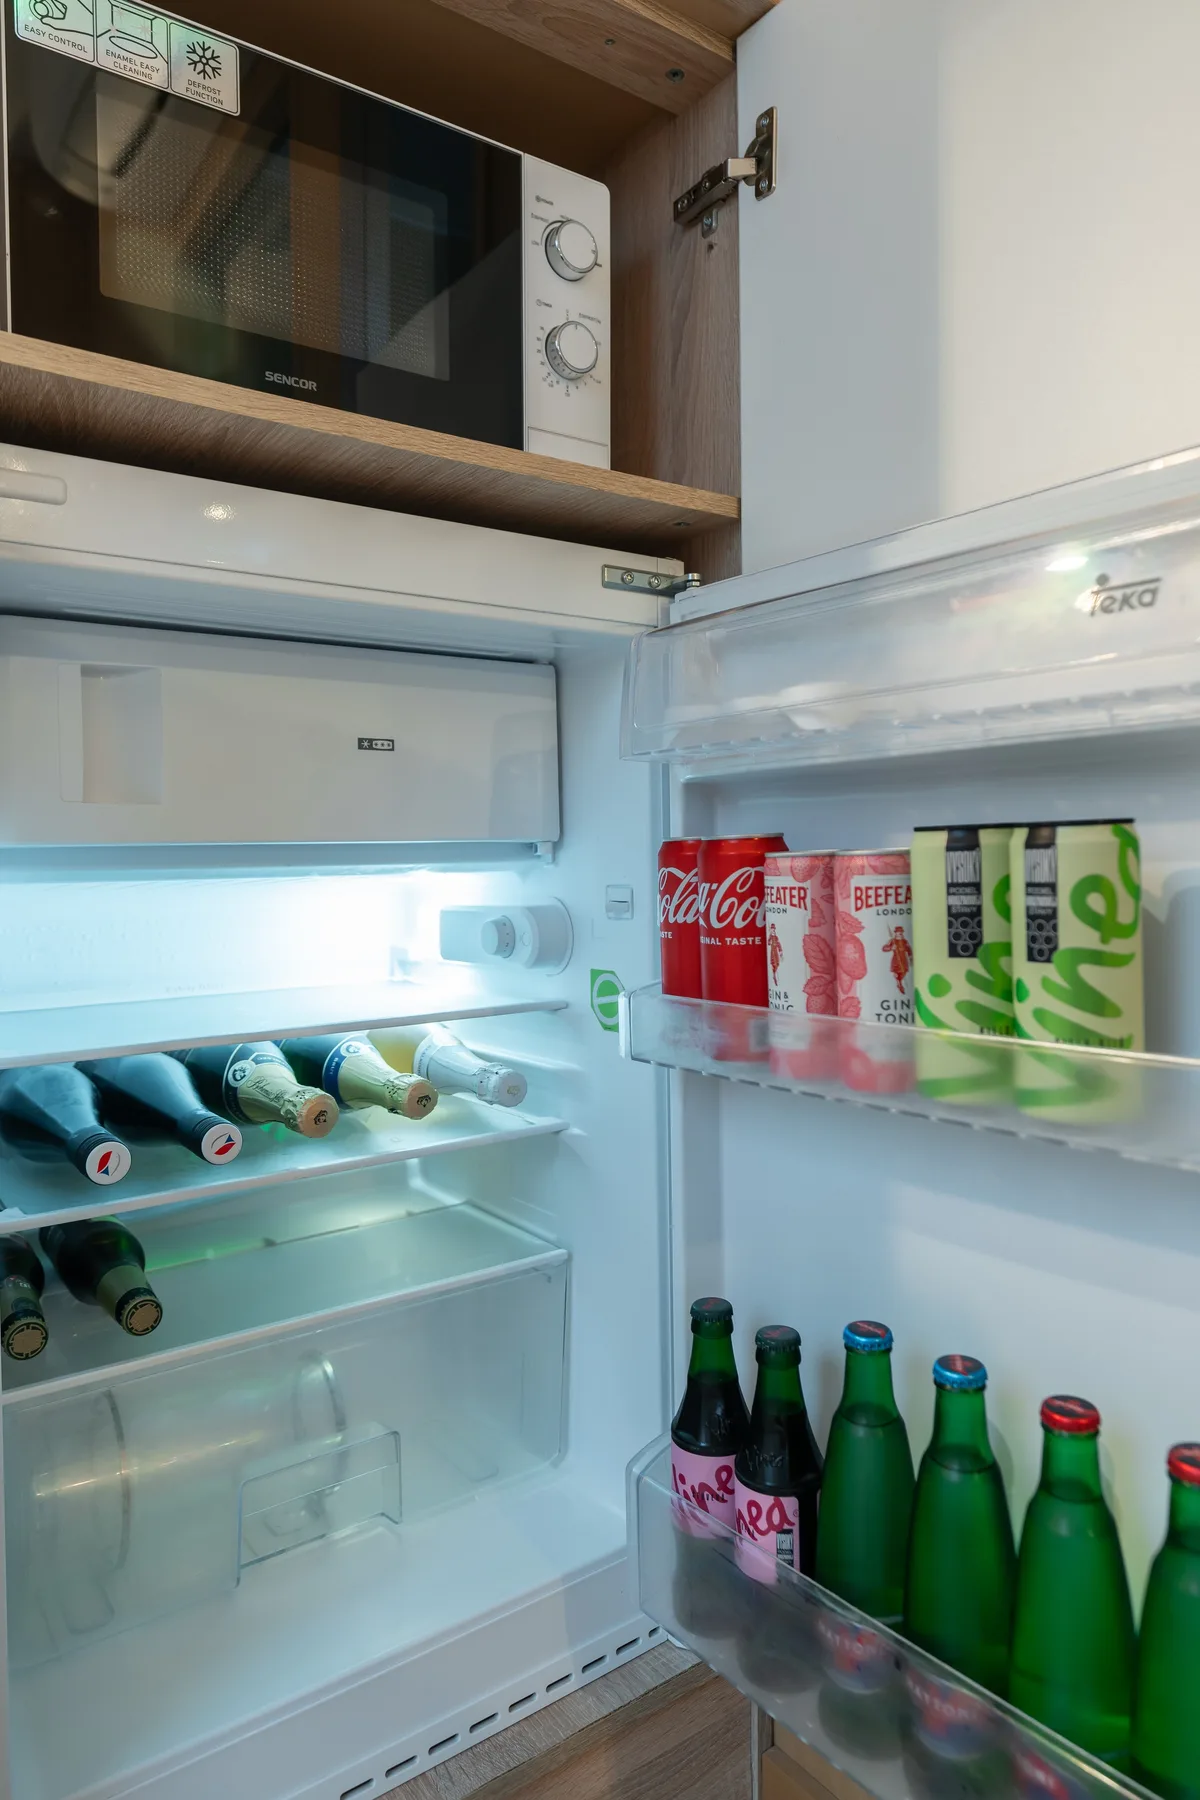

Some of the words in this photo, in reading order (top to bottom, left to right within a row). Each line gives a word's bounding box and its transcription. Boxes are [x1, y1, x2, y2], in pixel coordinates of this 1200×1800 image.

[24, 24, 46, 38] EASY
[48, 33, 88, 53] CONTROL
[105, 50, 139, 67] ENAMEL
[139, 60, 160, 74] EASY
[113, 61, 153, 81] CLEANING
[185, 87, 223, 106] FUNCTION
[187, 79, 221, 96] DEFROST
[265, 371, 318, 391] SENCOR
[725, 936, 762, 946] TASTE
[880, 999, 911, 1011] GIN
